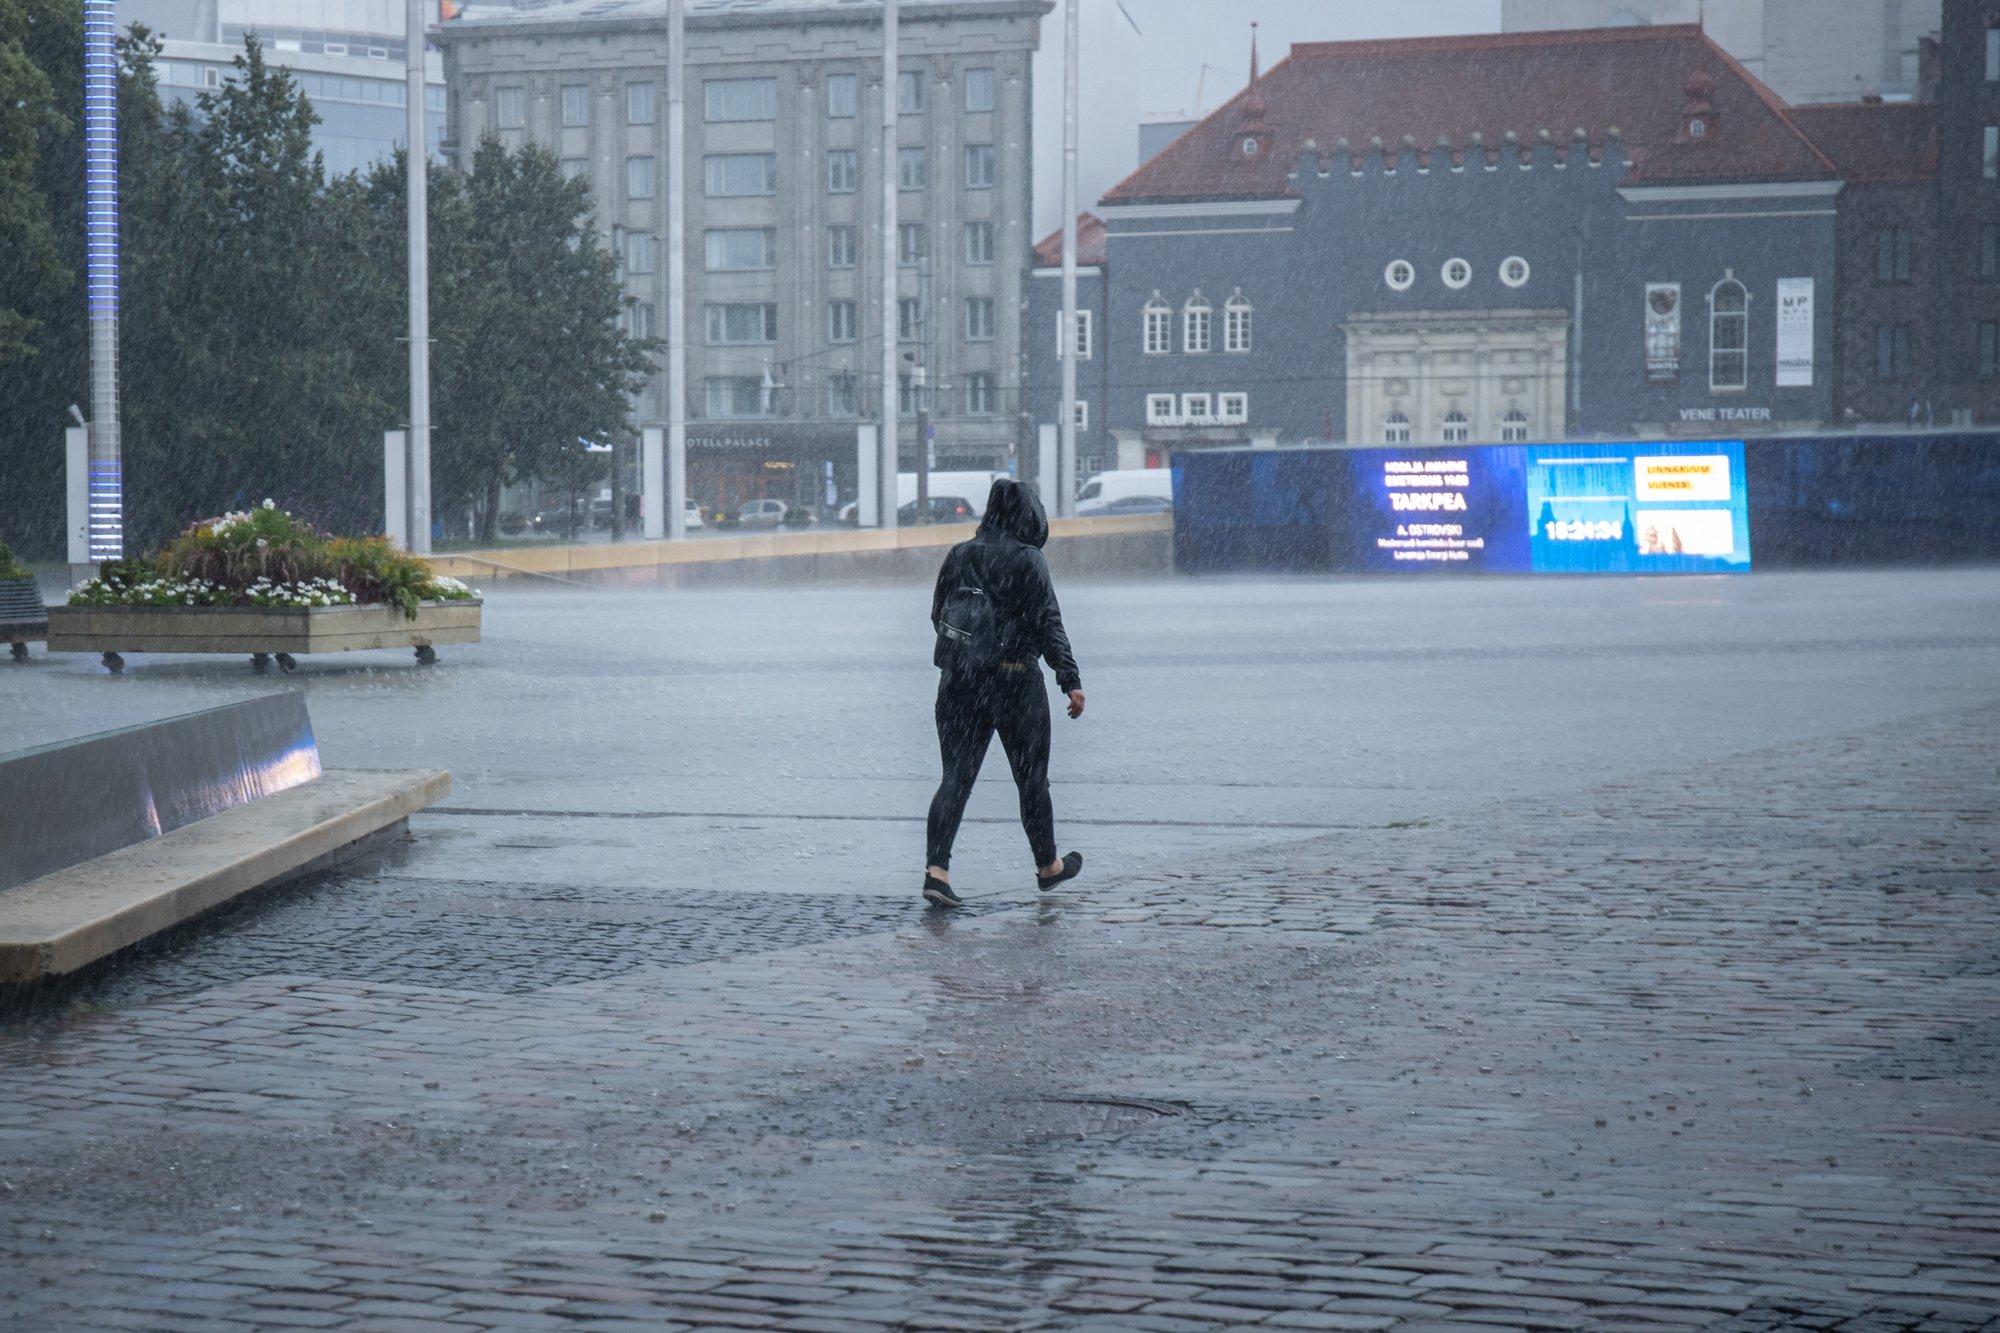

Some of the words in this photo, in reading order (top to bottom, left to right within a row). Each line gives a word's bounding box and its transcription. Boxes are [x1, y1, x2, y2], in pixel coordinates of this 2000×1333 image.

[1680, 408, 1715, 420] VENE
[1719, 407, 1771, 420] TEATER
[687, 437, 721, 447] OTELL
[725, 437, 770, 447] PALACE
[1389, 492, 1467, 511] TARKPEA
[1397, 524, 1408, 536] A.
[1408, 523, 1463, 536] OSTROVSKI
